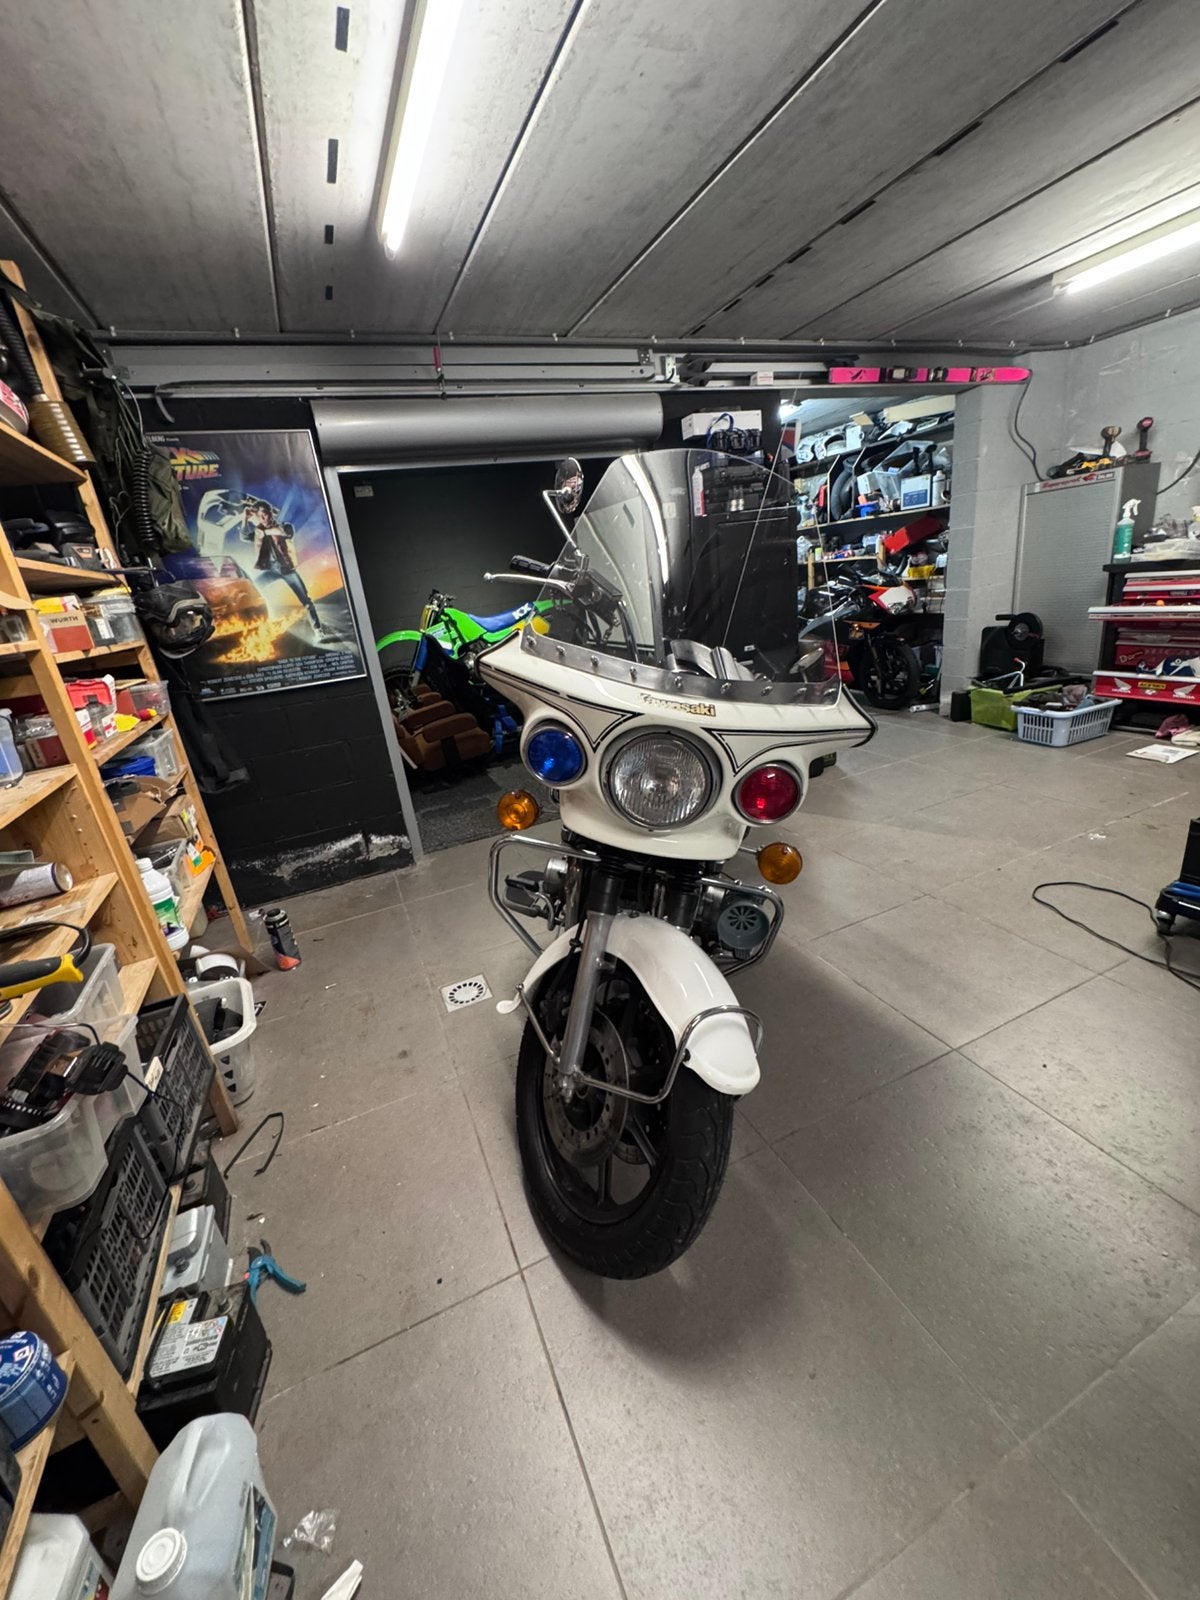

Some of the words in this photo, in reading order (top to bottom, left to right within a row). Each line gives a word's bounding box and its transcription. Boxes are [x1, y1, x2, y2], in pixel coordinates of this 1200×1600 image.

[174, 463, 219, 481] TURE
[512, 602, 532, 620] KX
[640, 692, 717, 718] Kawasaki
